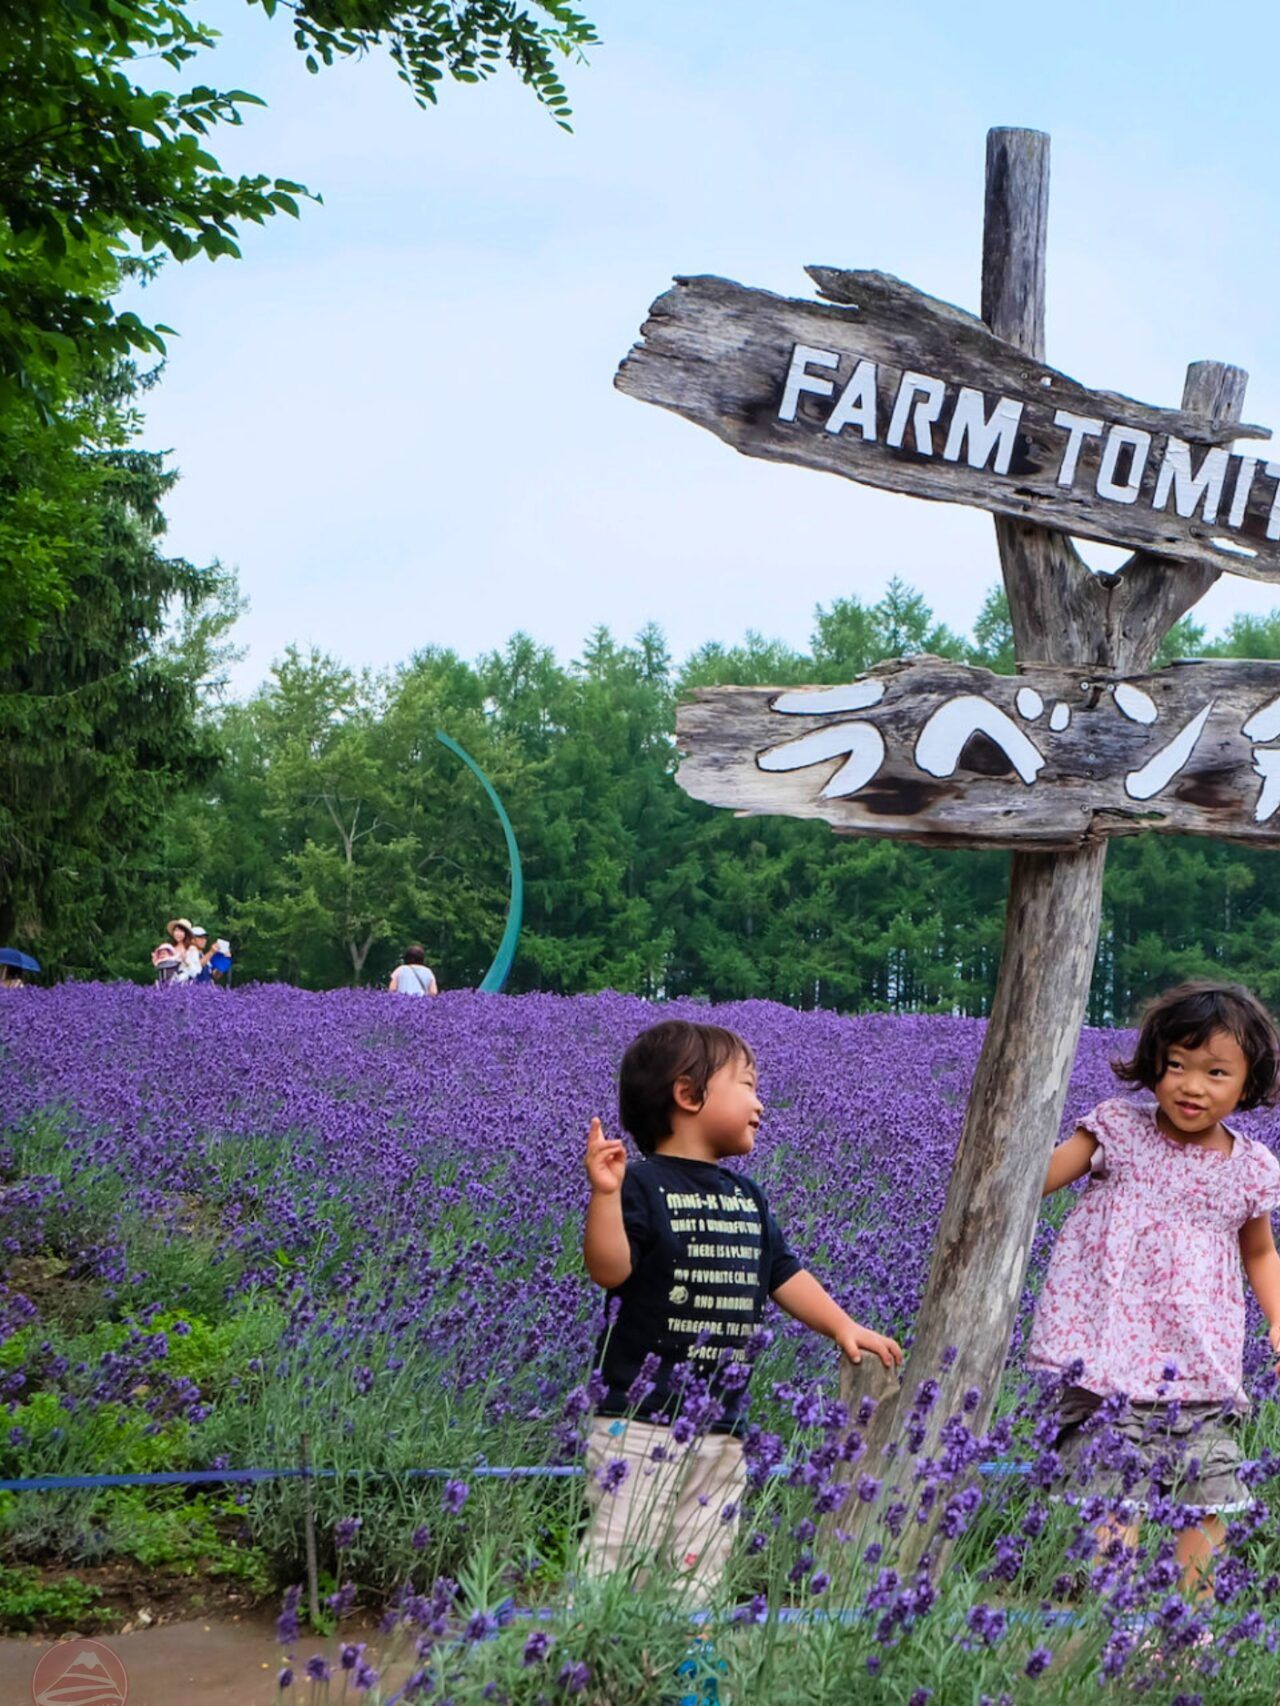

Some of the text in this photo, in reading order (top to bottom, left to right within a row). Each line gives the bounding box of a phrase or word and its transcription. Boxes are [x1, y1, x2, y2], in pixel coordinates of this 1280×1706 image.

[776, 343, 1024, 476] FARM
[670, 1219, 696, 1233] WHAT
[687, 1244, 715, 1258] THERE
[691, 1269, 734, 1284] FAVORITE
[694, 1295, 714, 1309] AND
